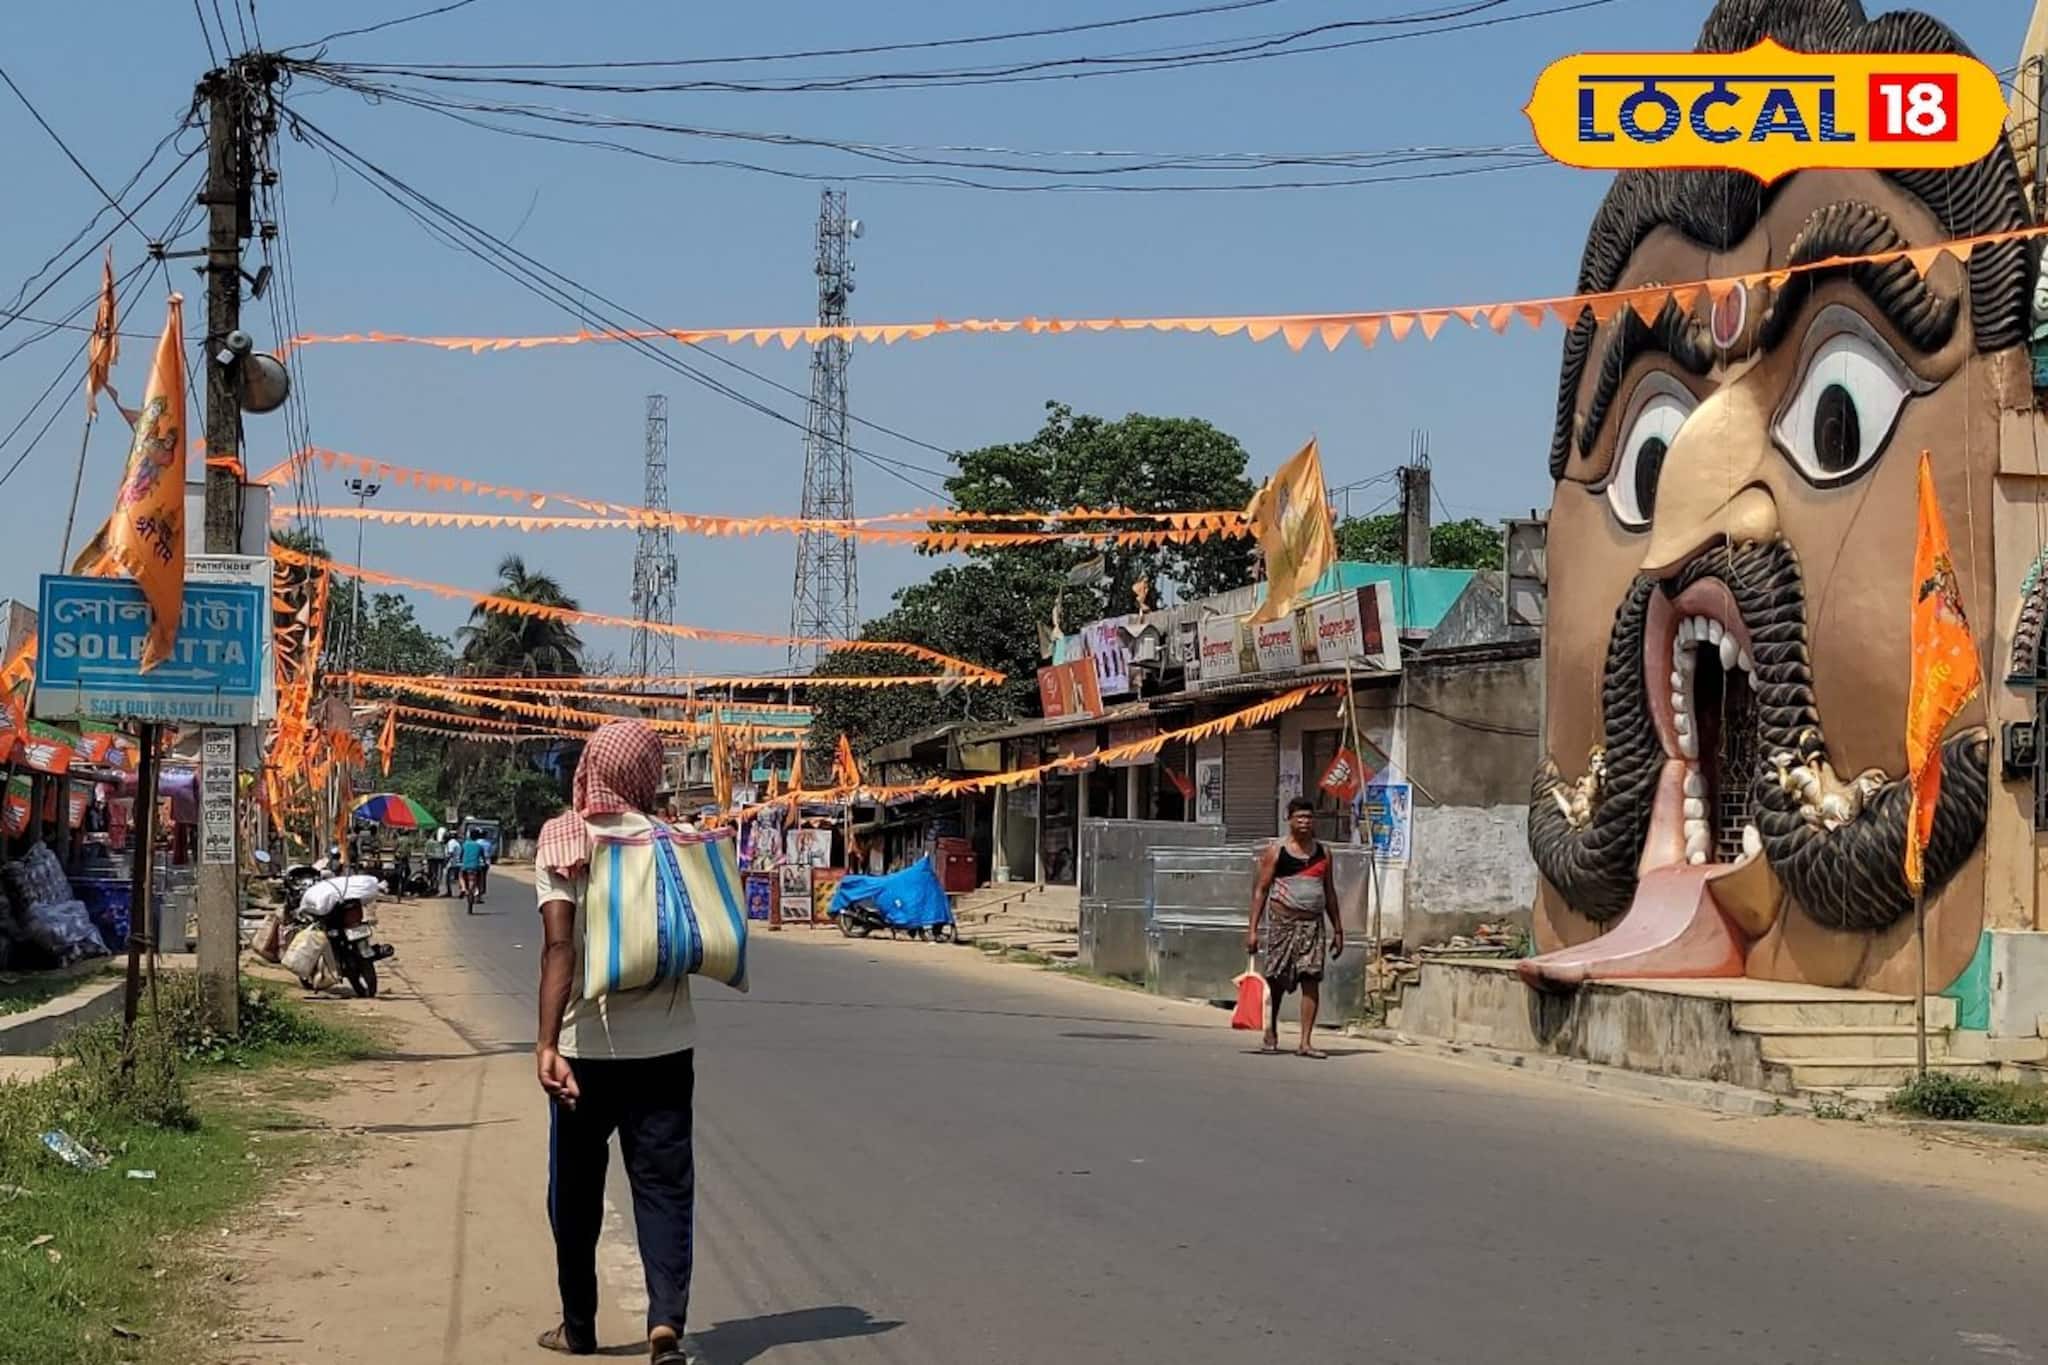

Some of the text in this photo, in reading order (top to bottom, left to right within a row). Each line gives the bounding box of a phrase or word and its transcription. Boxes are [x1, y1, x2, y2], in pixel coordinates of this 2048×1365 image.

[54, 597, 247, 630] সোলাট্টা
[53, 633, 246, 665] SOLPTTA
[90, 699, 234, 717] SAFE DRIVE SAVE LIFE
